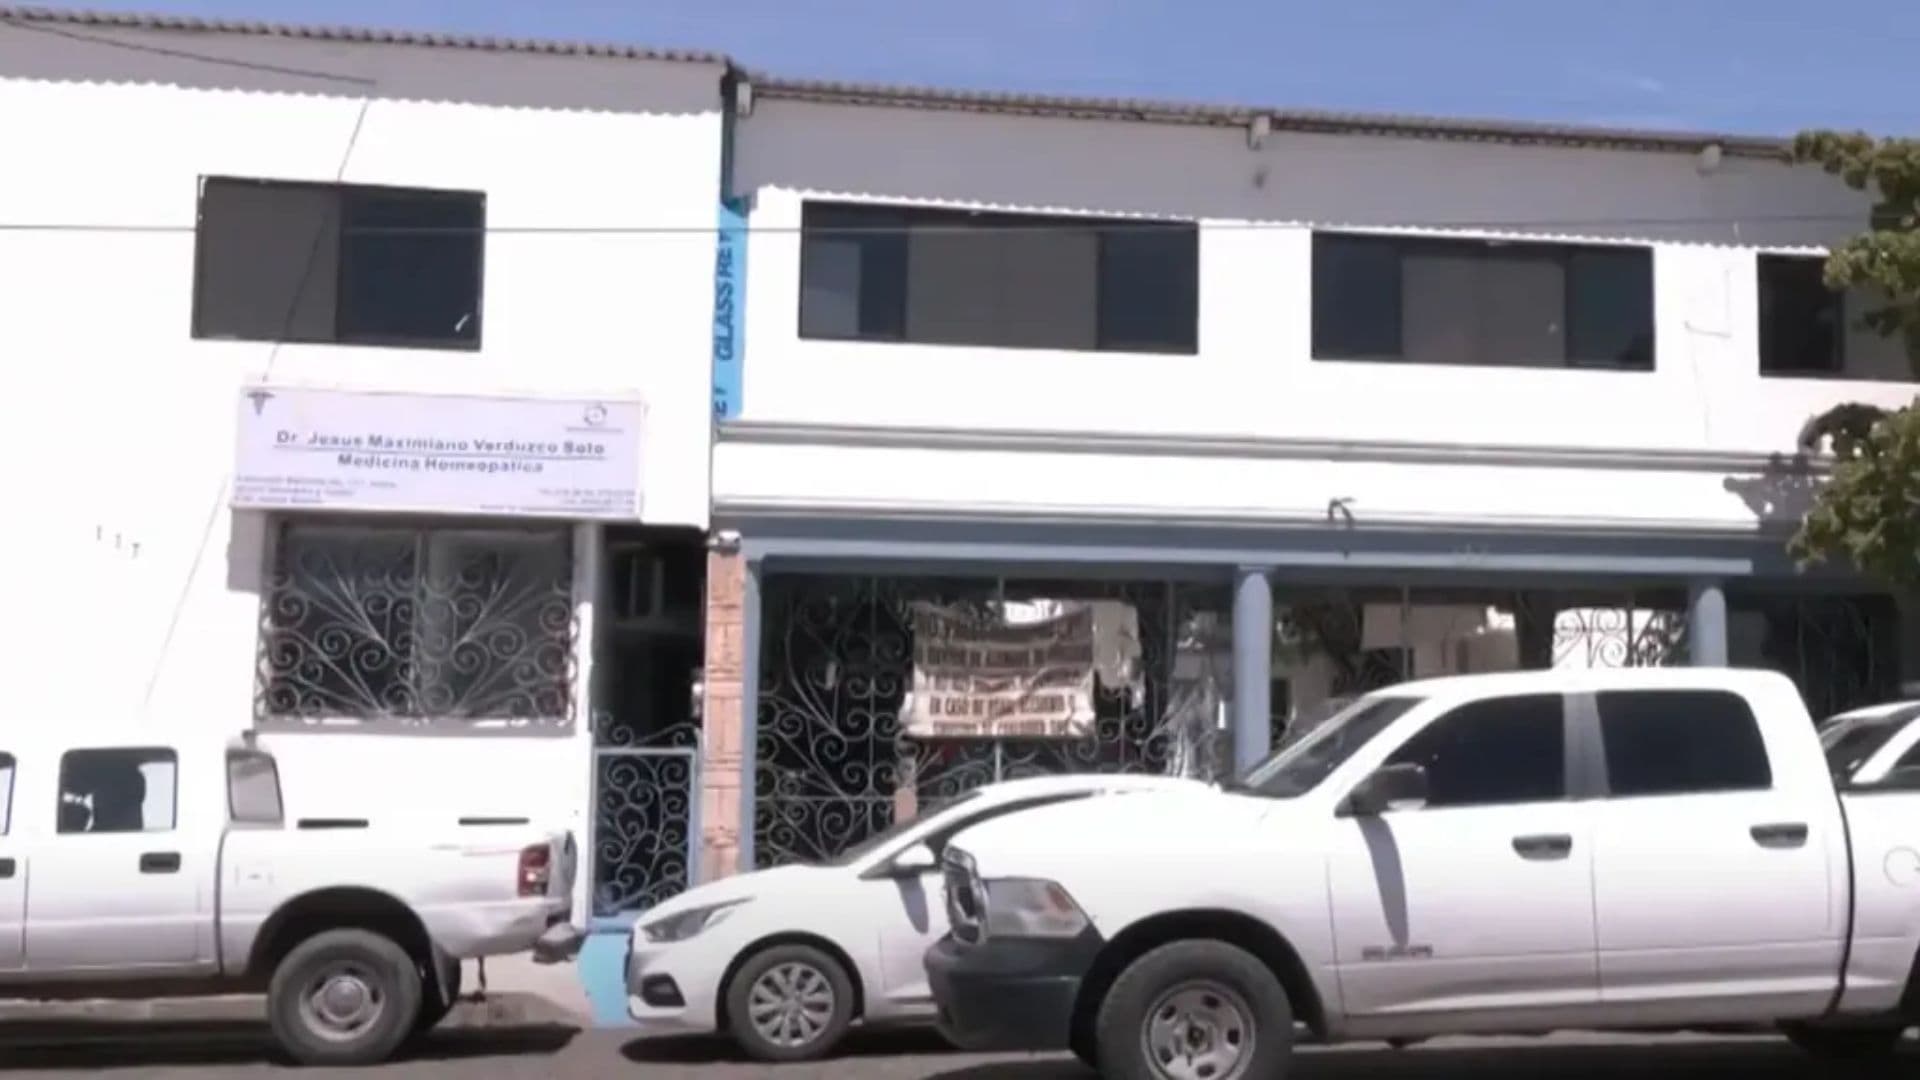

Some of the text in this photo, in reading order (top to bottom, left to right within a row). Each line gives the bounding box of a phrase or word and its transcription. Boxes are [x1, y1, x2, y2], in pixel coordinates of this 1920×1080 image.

[368, 434, 468, 451] Maximiano
[473, 439, 558, 453] Verduzco
[563, 440, 606, 454] Soto
[337, 453, 420, 470] Medicina
